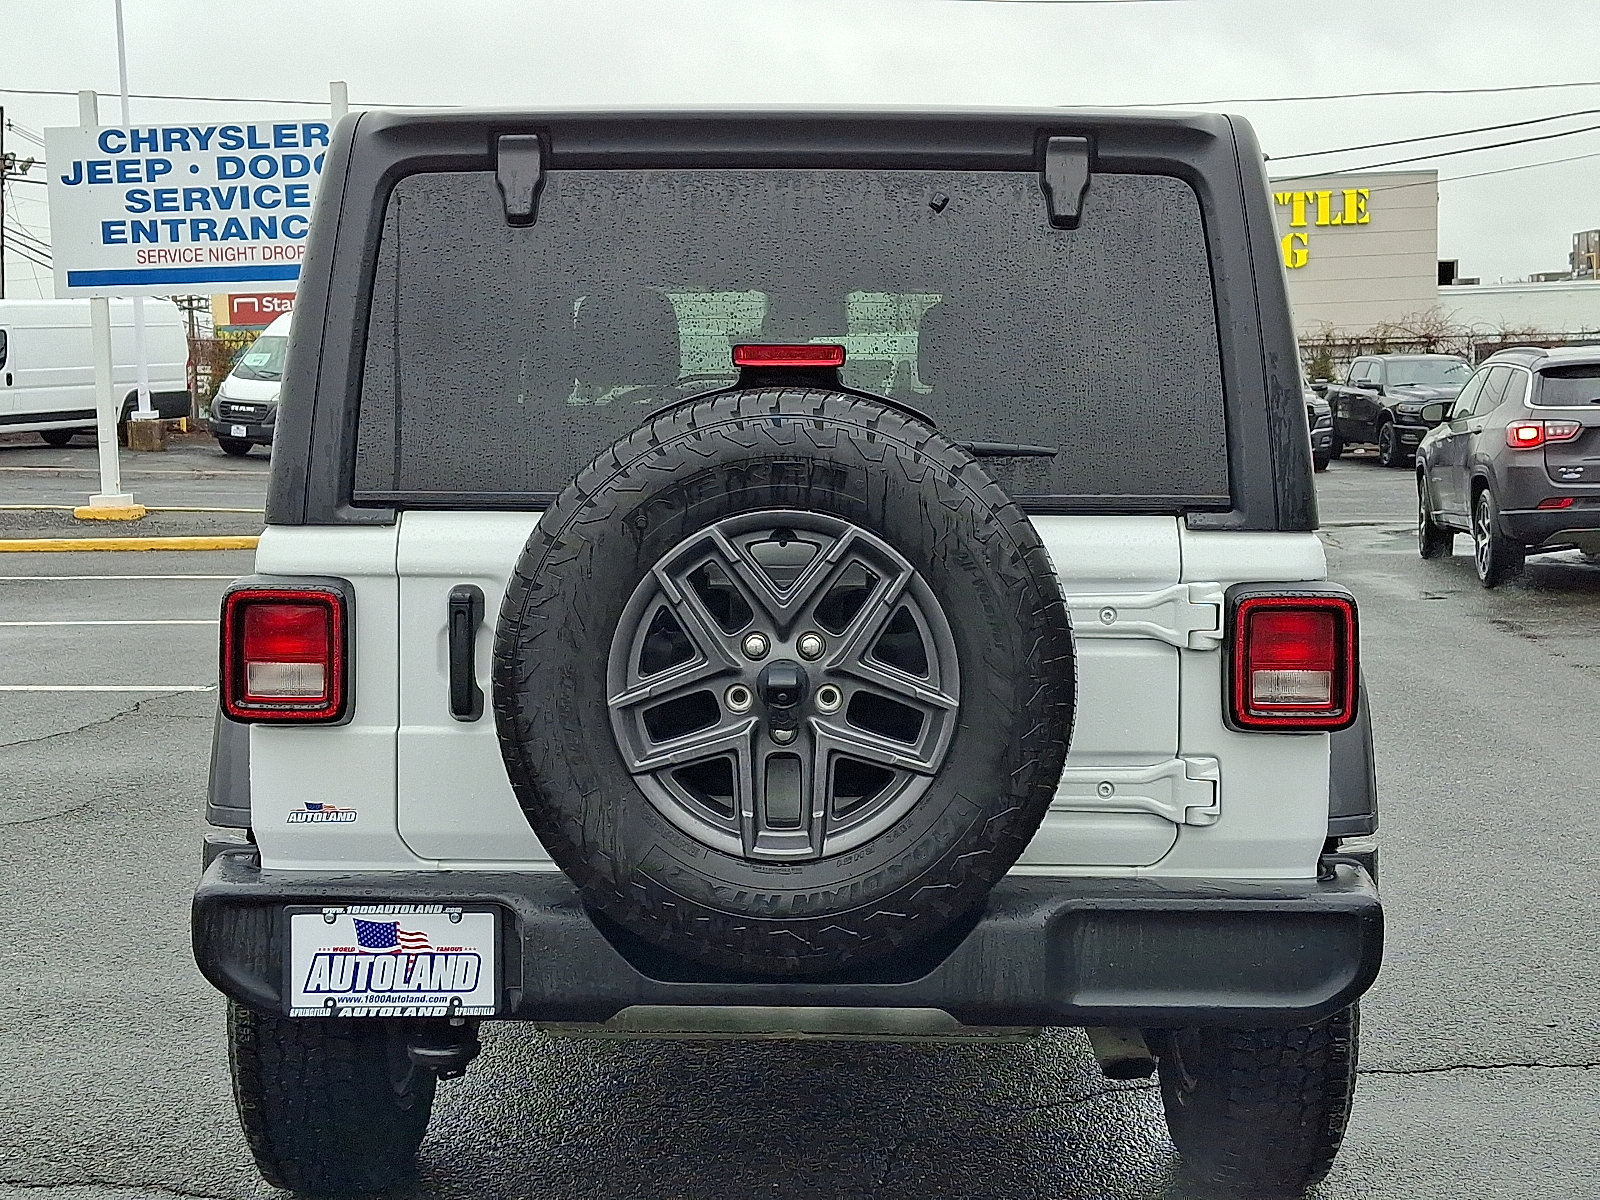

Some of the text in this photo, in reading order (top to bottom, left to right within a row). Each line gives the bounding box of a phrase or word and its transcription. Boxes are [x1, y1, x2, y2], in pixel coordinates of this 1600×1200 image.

[98, 123, 329, 153] CHRYSLER
[61, 151, 325, 186] JEEP DOD
[125, 184, 310, 213] SERVICE
[137, 245, 305, 264] SERVICE NIGHT DROP
[287, 811, 358, 823] AUTOLAND
[303, 954, 481, 993] AUTOLAND
[337, 995, 447, 1004] www.1800Autoland.com
[338, 1007, 448, 1017] AUTOLAND
